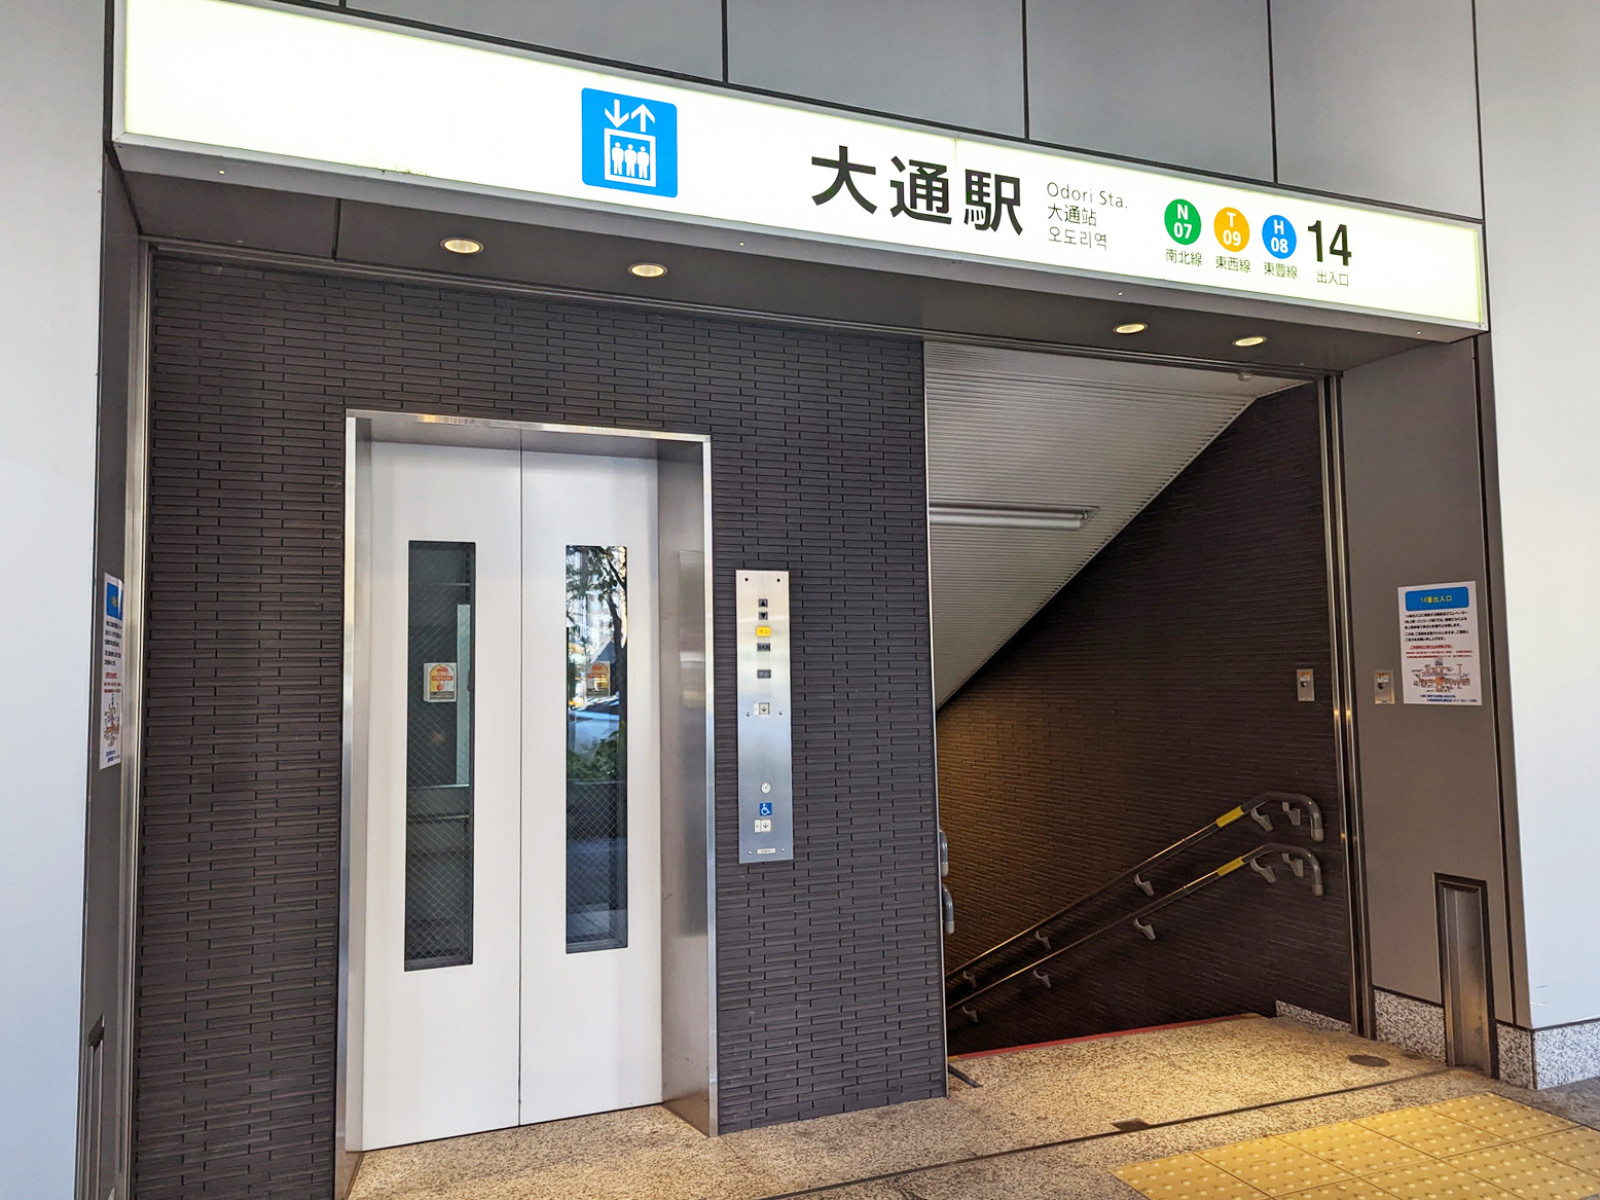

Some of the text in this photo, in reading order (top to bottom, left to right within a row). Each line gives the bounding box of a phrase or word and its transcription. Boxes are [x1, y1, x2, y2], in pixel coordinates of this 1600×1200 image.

[811, 145, 1023, 236] 大通駅
[1047, 181, 1128, 209] Odori Sta.
[1047, 202, 1097, 227] 大通站
[1177, 204, 1189, 221] N
[1226, 212, 1236, 227] T
[1173, 222, 1193, 239] 07
[1273, 219, 1285, 236] H
[1048, 226, 1107, 251] 오도리역
[1223, 230, 1242, 247] 09
[1270, 237, 1289, 254] 08
[1307, 219, 1352, 267] 14
[1165, 248, 1203, 267] 南北線
[1215, 255, 1252, 274] 東西線
[1316, 270, 1350, 287] 出入口
